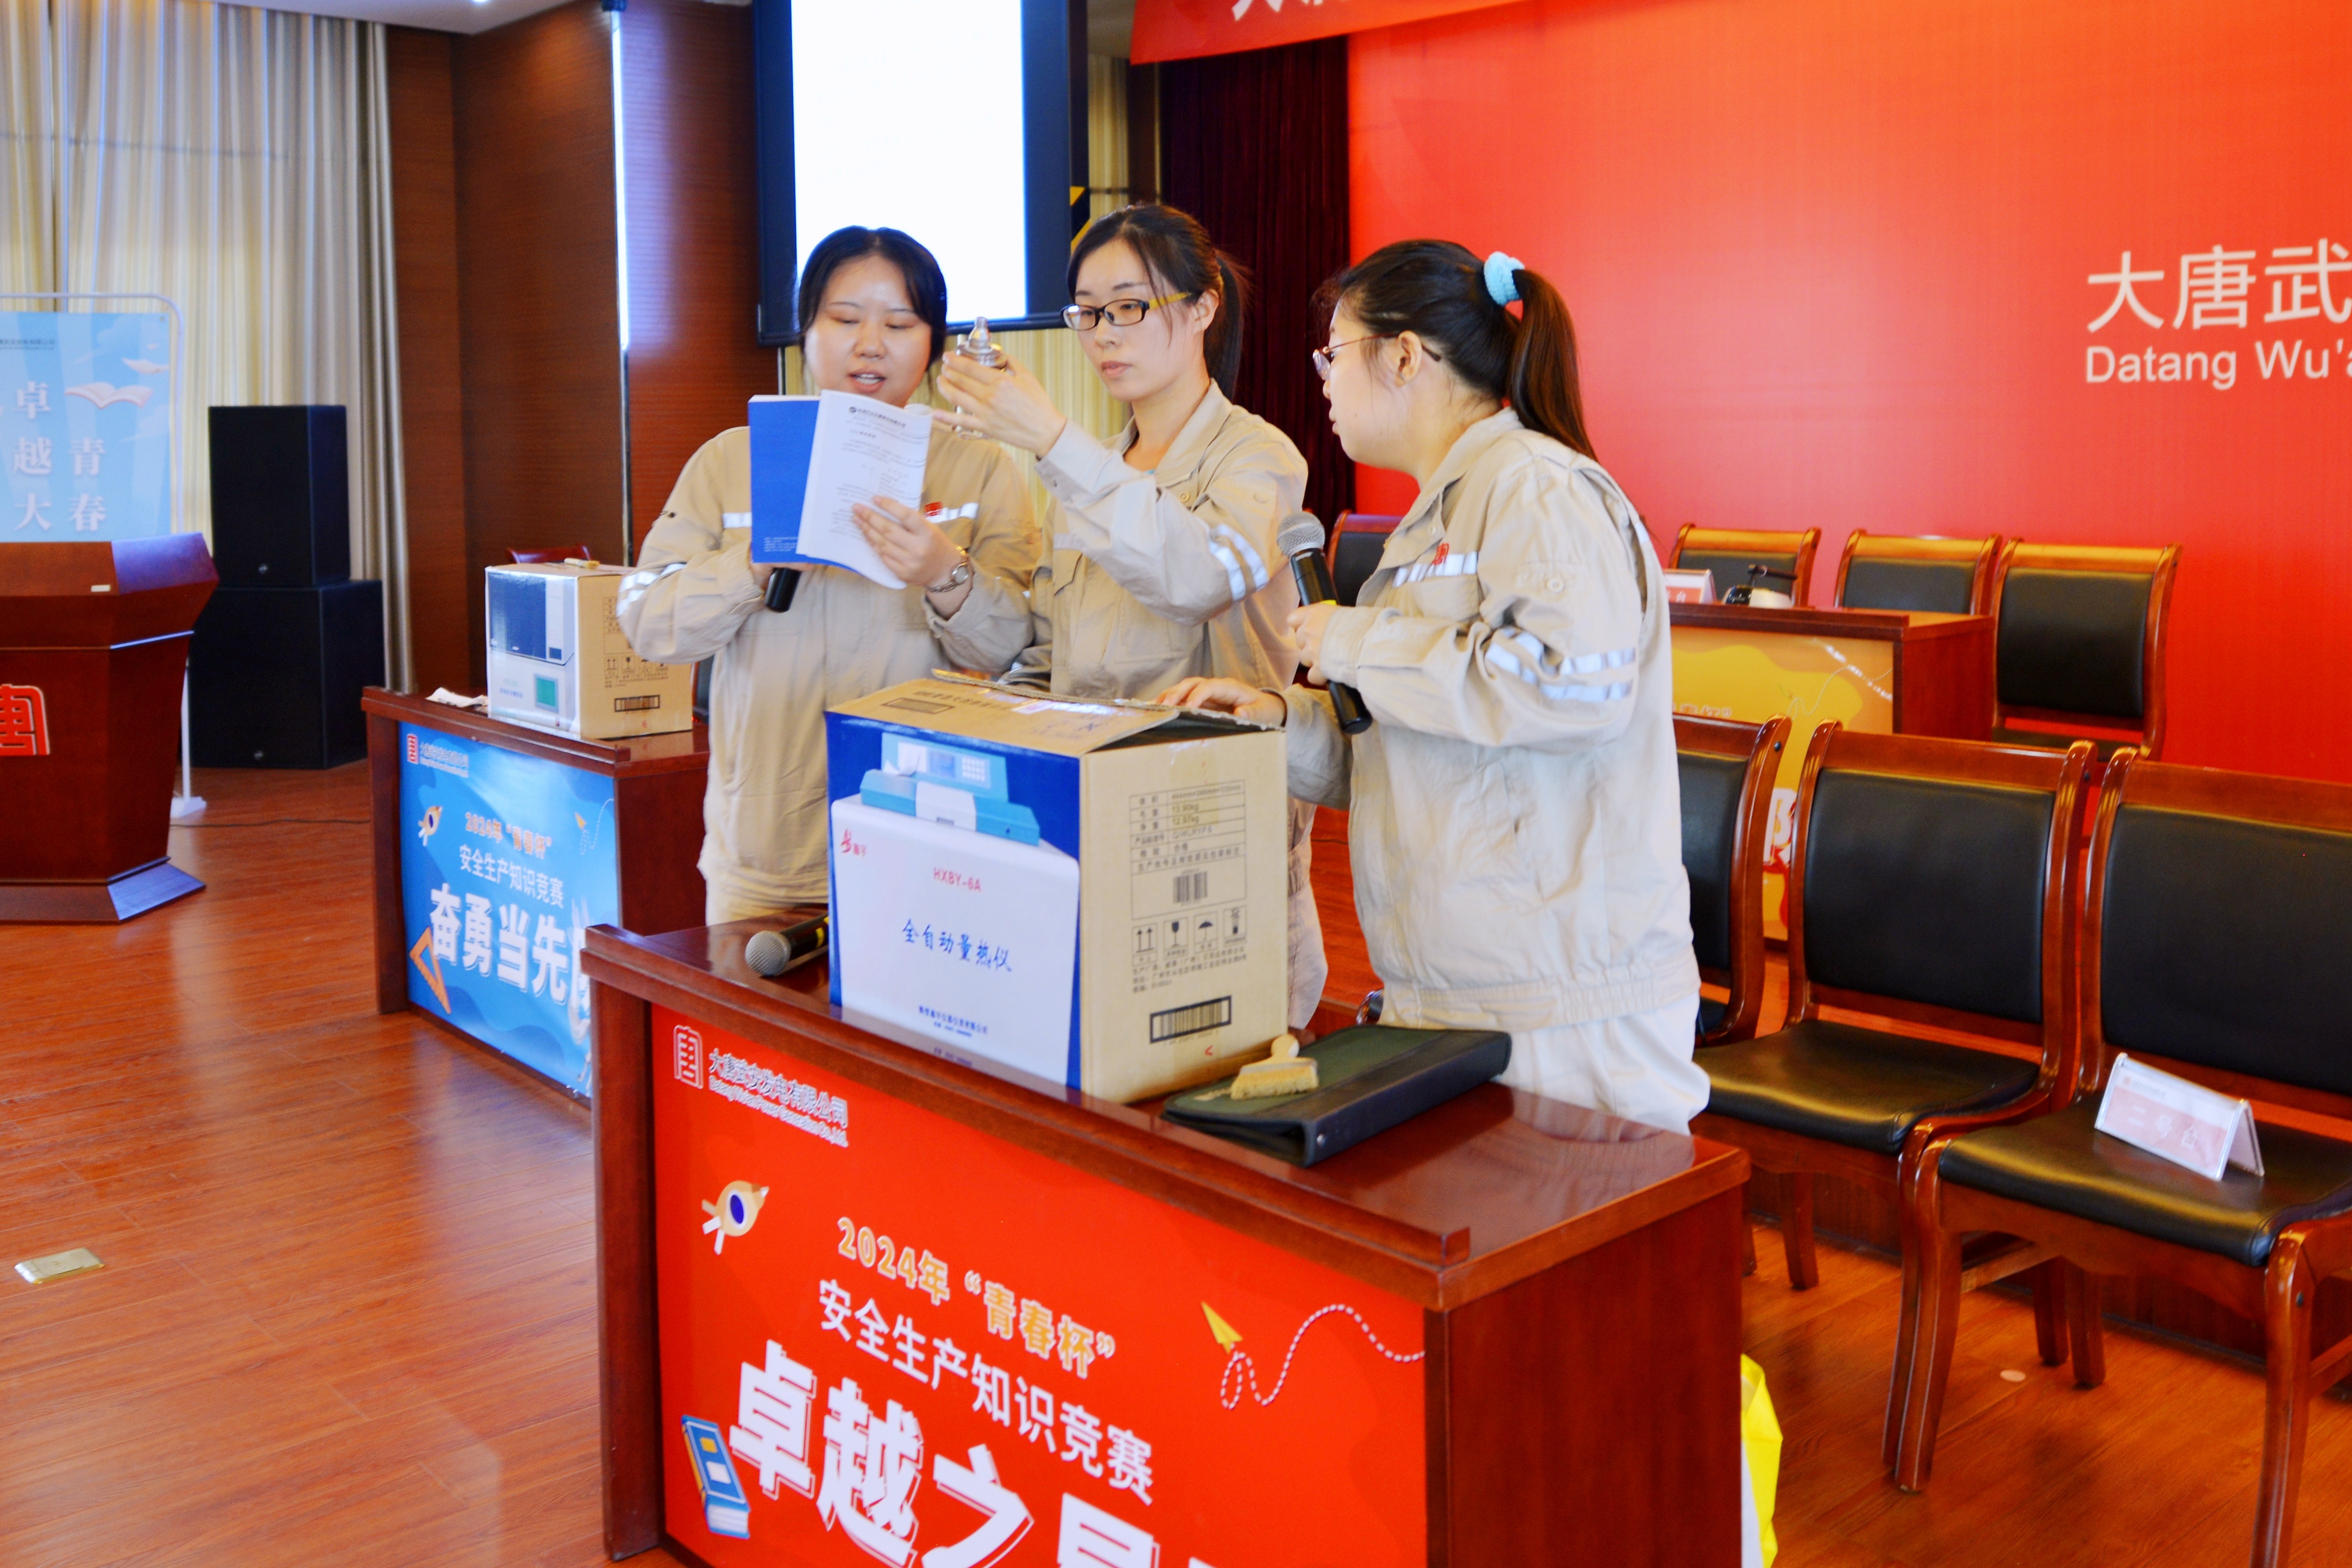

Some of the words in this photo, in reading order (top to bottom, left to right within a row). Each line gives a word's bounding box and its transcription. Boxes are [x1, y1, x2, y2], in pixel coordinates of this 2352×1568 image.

[2087, 238, 2352, 333] 大唐武
[2086, 346, 2237, 391] Datang
[2255, 339, 2352, 380] Wu'
[459, 844, 564, 909] 安全生产知识竞赛
[902, 919, 1012, 972] 全自动量热仪
[836, 1216, 1116, 1379] 2024年“青春杯”
[818, 1279, 1154, 1506] 安全生产知识竞赛
